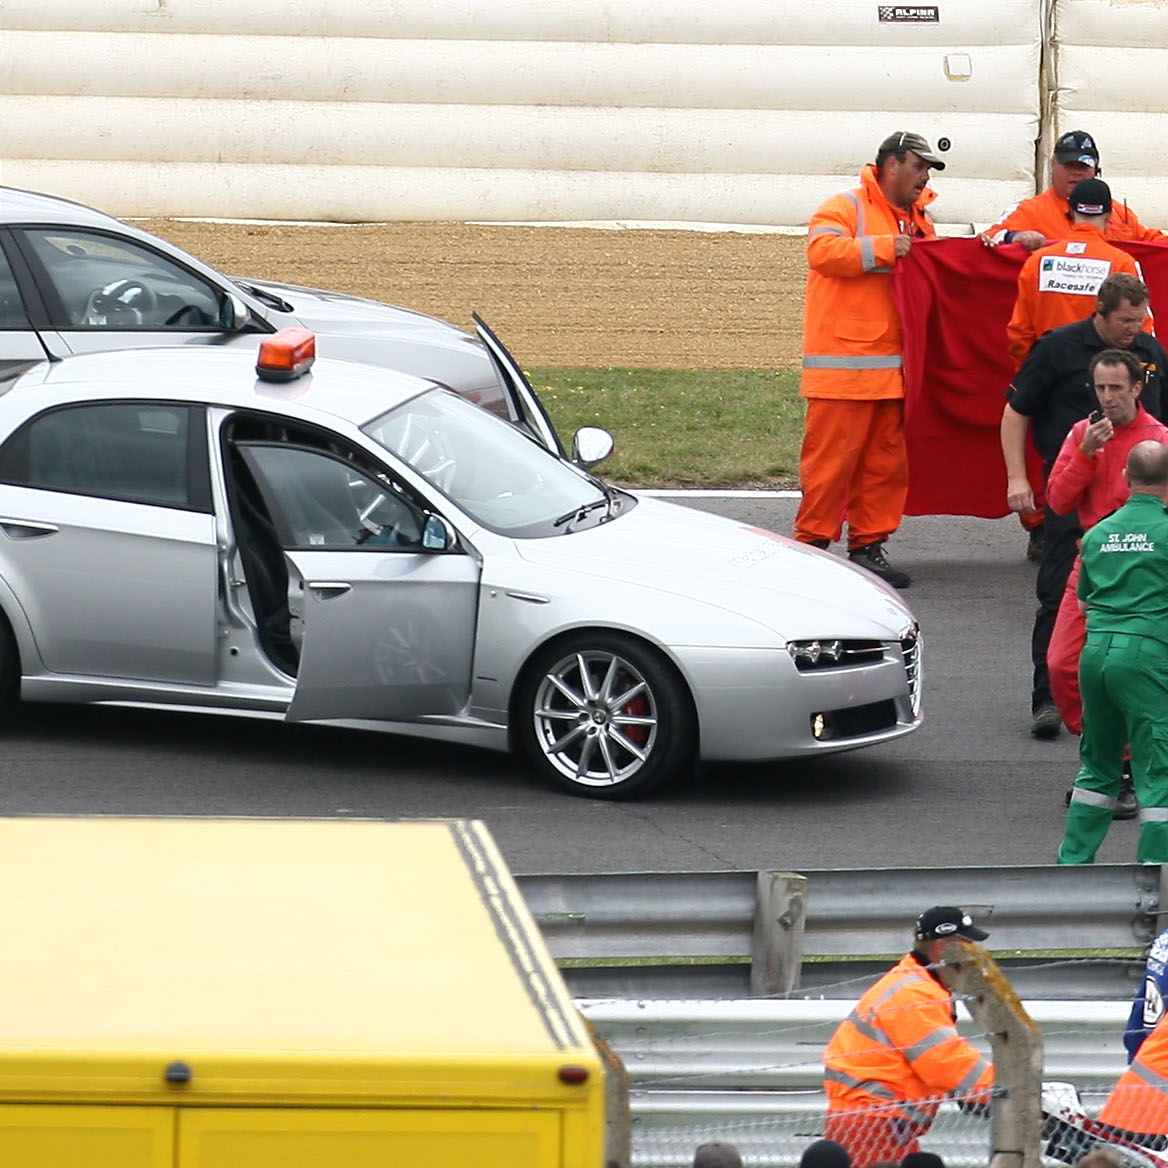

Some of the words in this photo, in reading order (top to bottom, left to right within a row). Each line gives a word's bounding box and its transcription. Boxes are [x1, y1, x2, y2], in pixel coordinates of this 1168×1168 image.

[895, 8, 935, 17] ALPINA
[1056, 260, 1106, 275] blackhorse
[1047, 279, 1096, 292] Racesafe
[1122, 533, 1147, 542] JOHN
[1099, 542, 1154, 552] AMBULANCE
